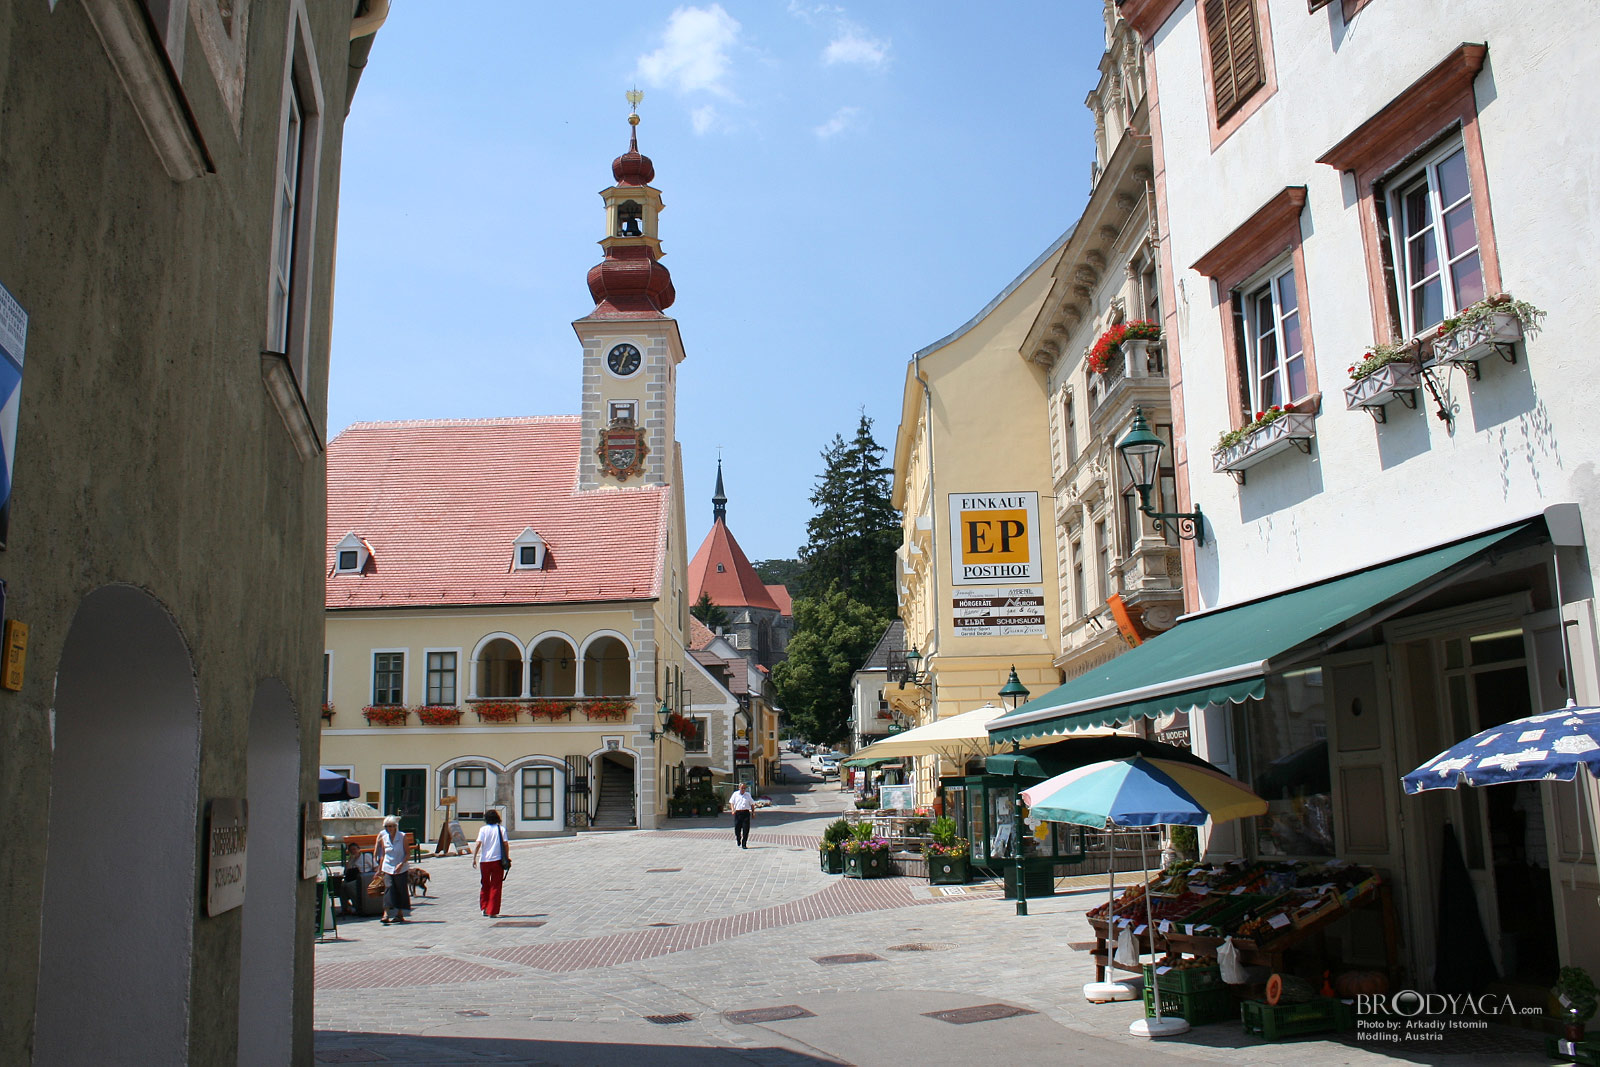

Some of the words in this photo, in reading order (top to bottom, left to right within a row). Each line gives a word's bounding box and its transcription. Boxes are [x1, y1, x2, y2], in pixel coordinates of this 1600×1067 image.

[962, 497, 1026, 509] EINKAUF
[964, 520, 1025, 554] EP
[963, 565, 1030, 577] POSTHOF
[959, 599, 992, 607] HÖRGERÄTE
[996, 617, 1041, 625] SCHUHSALON
